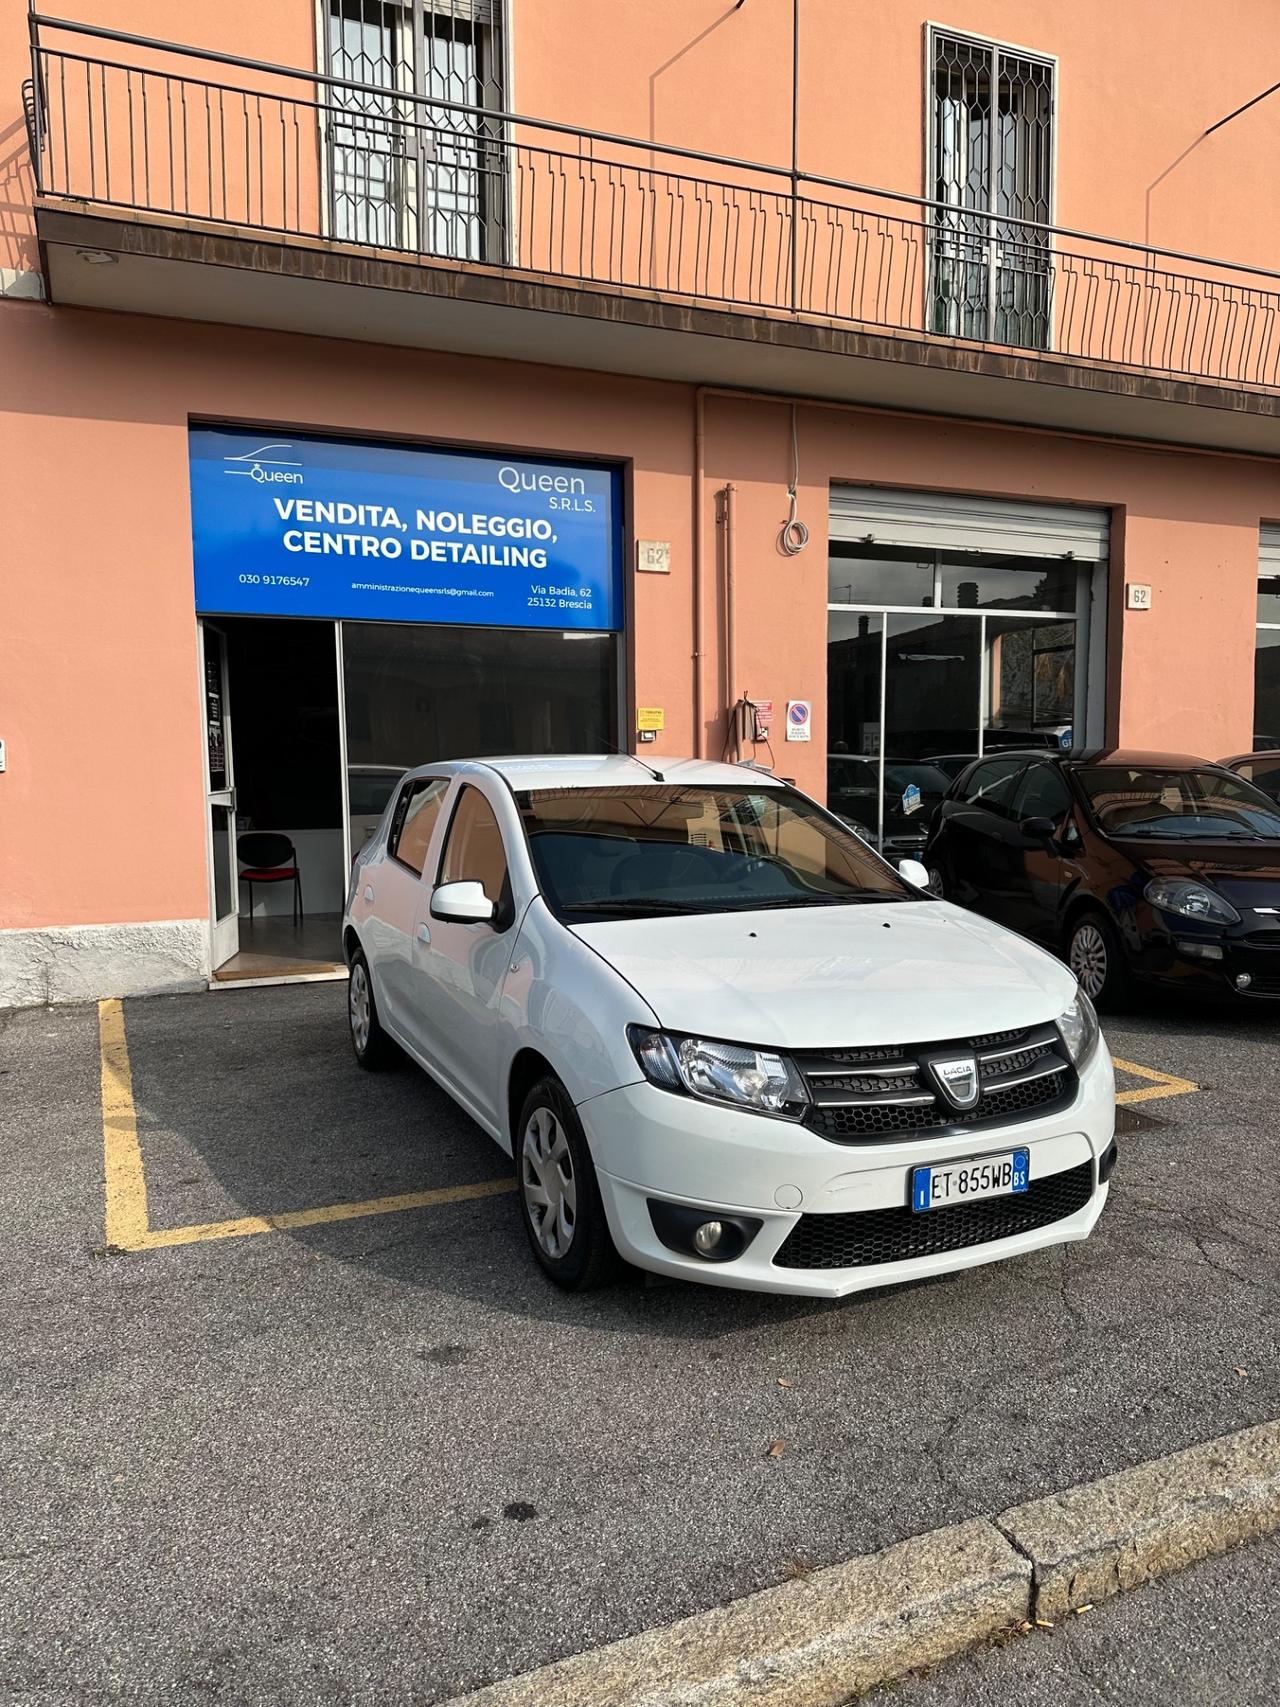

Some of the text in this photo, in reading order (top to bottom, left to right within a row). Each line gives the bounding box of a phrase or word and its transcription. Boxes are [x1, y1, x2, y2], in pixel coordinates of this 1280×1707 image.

[250, 467, 303, 484] Queen
[498, 466, 585, 495] Queen
[549, 496, 596, 513] S.R.L.S.
[273, 497, 559, 543] VENDITA, NOLEGGIO,
[283, 531, 547, 569] CENTRO DETAILING
[239, 574, 310, 587] 030 9176547
[351, 582, 495, 597] amministrazionequeensrls@gmail.com
[531, 585, 547, 595] Via
[579, 588, 592, 598] 62
[1134, 589, 1147, 603] 62
[527, 597, 593, 610] 25132 Brescia
[932, 1162, 1013, 1200] ET 855WB
[1013, 1171, 1026, 1186] BS
